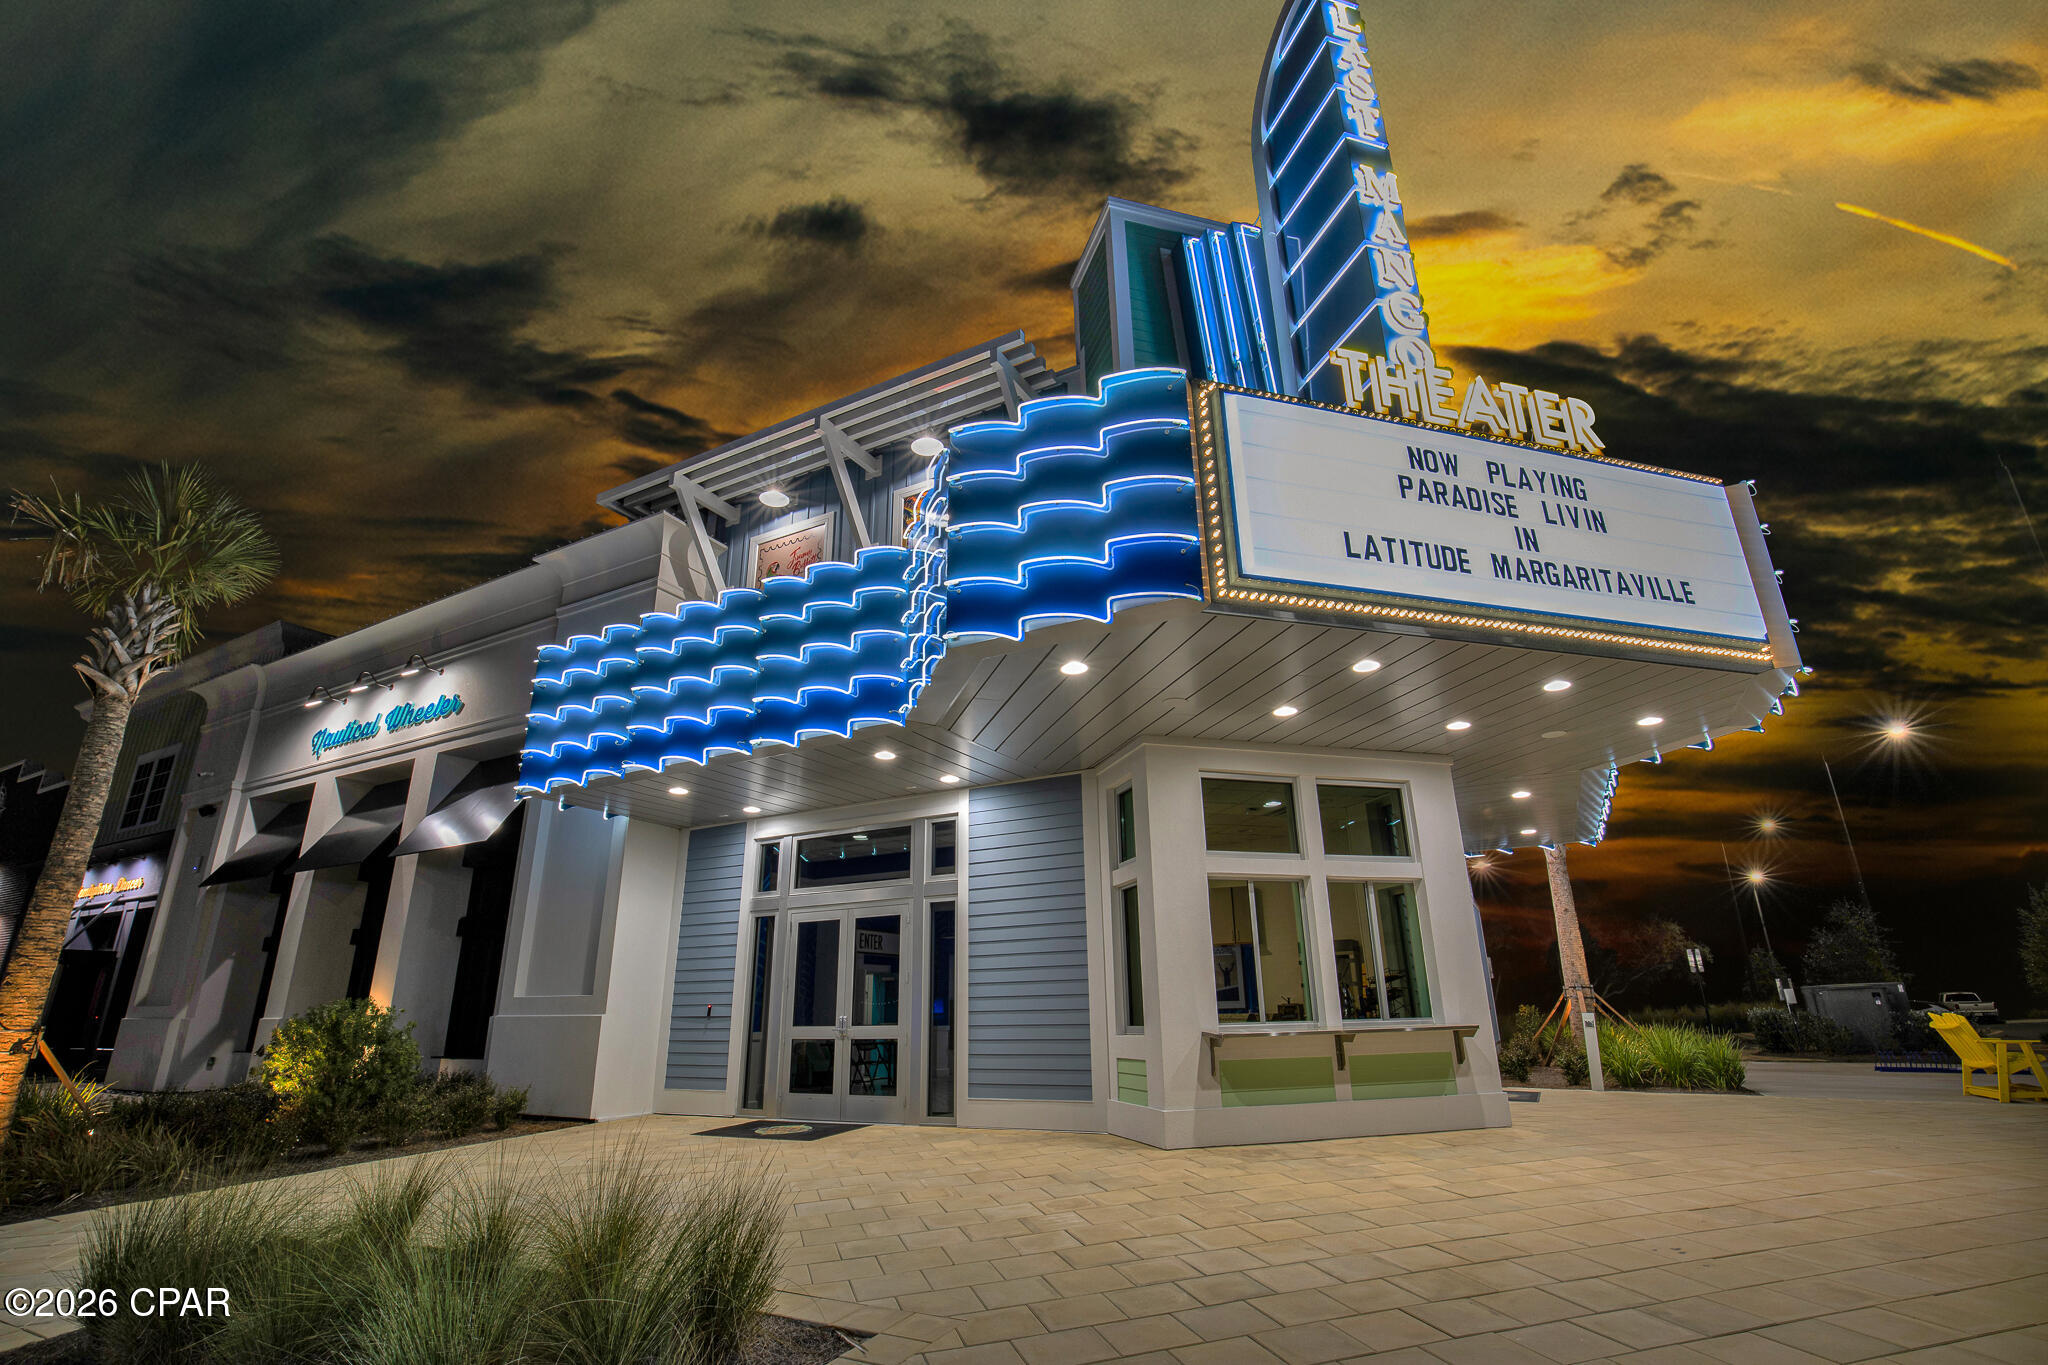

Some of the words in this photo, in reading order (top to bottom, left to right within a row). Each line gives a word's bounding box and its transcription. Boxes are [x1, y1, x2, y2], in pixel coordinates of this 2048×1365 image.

[1329, 2, 1379, 141] LAST
[1355, 164, 1436, 372] MANGO
[1330, 348, 1606, 453] THEATER
[1399, 475, 1519, 519] PARADISE
[1541, 501, 1608, 533] LIVIN
[1406, 446, 1459, 477] NOW
[1486, 460, 1587, 501] PLAYING
[1344, 532, 1472, 574] LATITUDE
[1490, 553, 1696, 604] MARGARITAVILLE
[1514, 526, 1540, 552] IN
[312, 713, 382, 760] Nautical
[385, 694, 465, 733] Wheeler
[859, 932, 883, 950] ENTER
